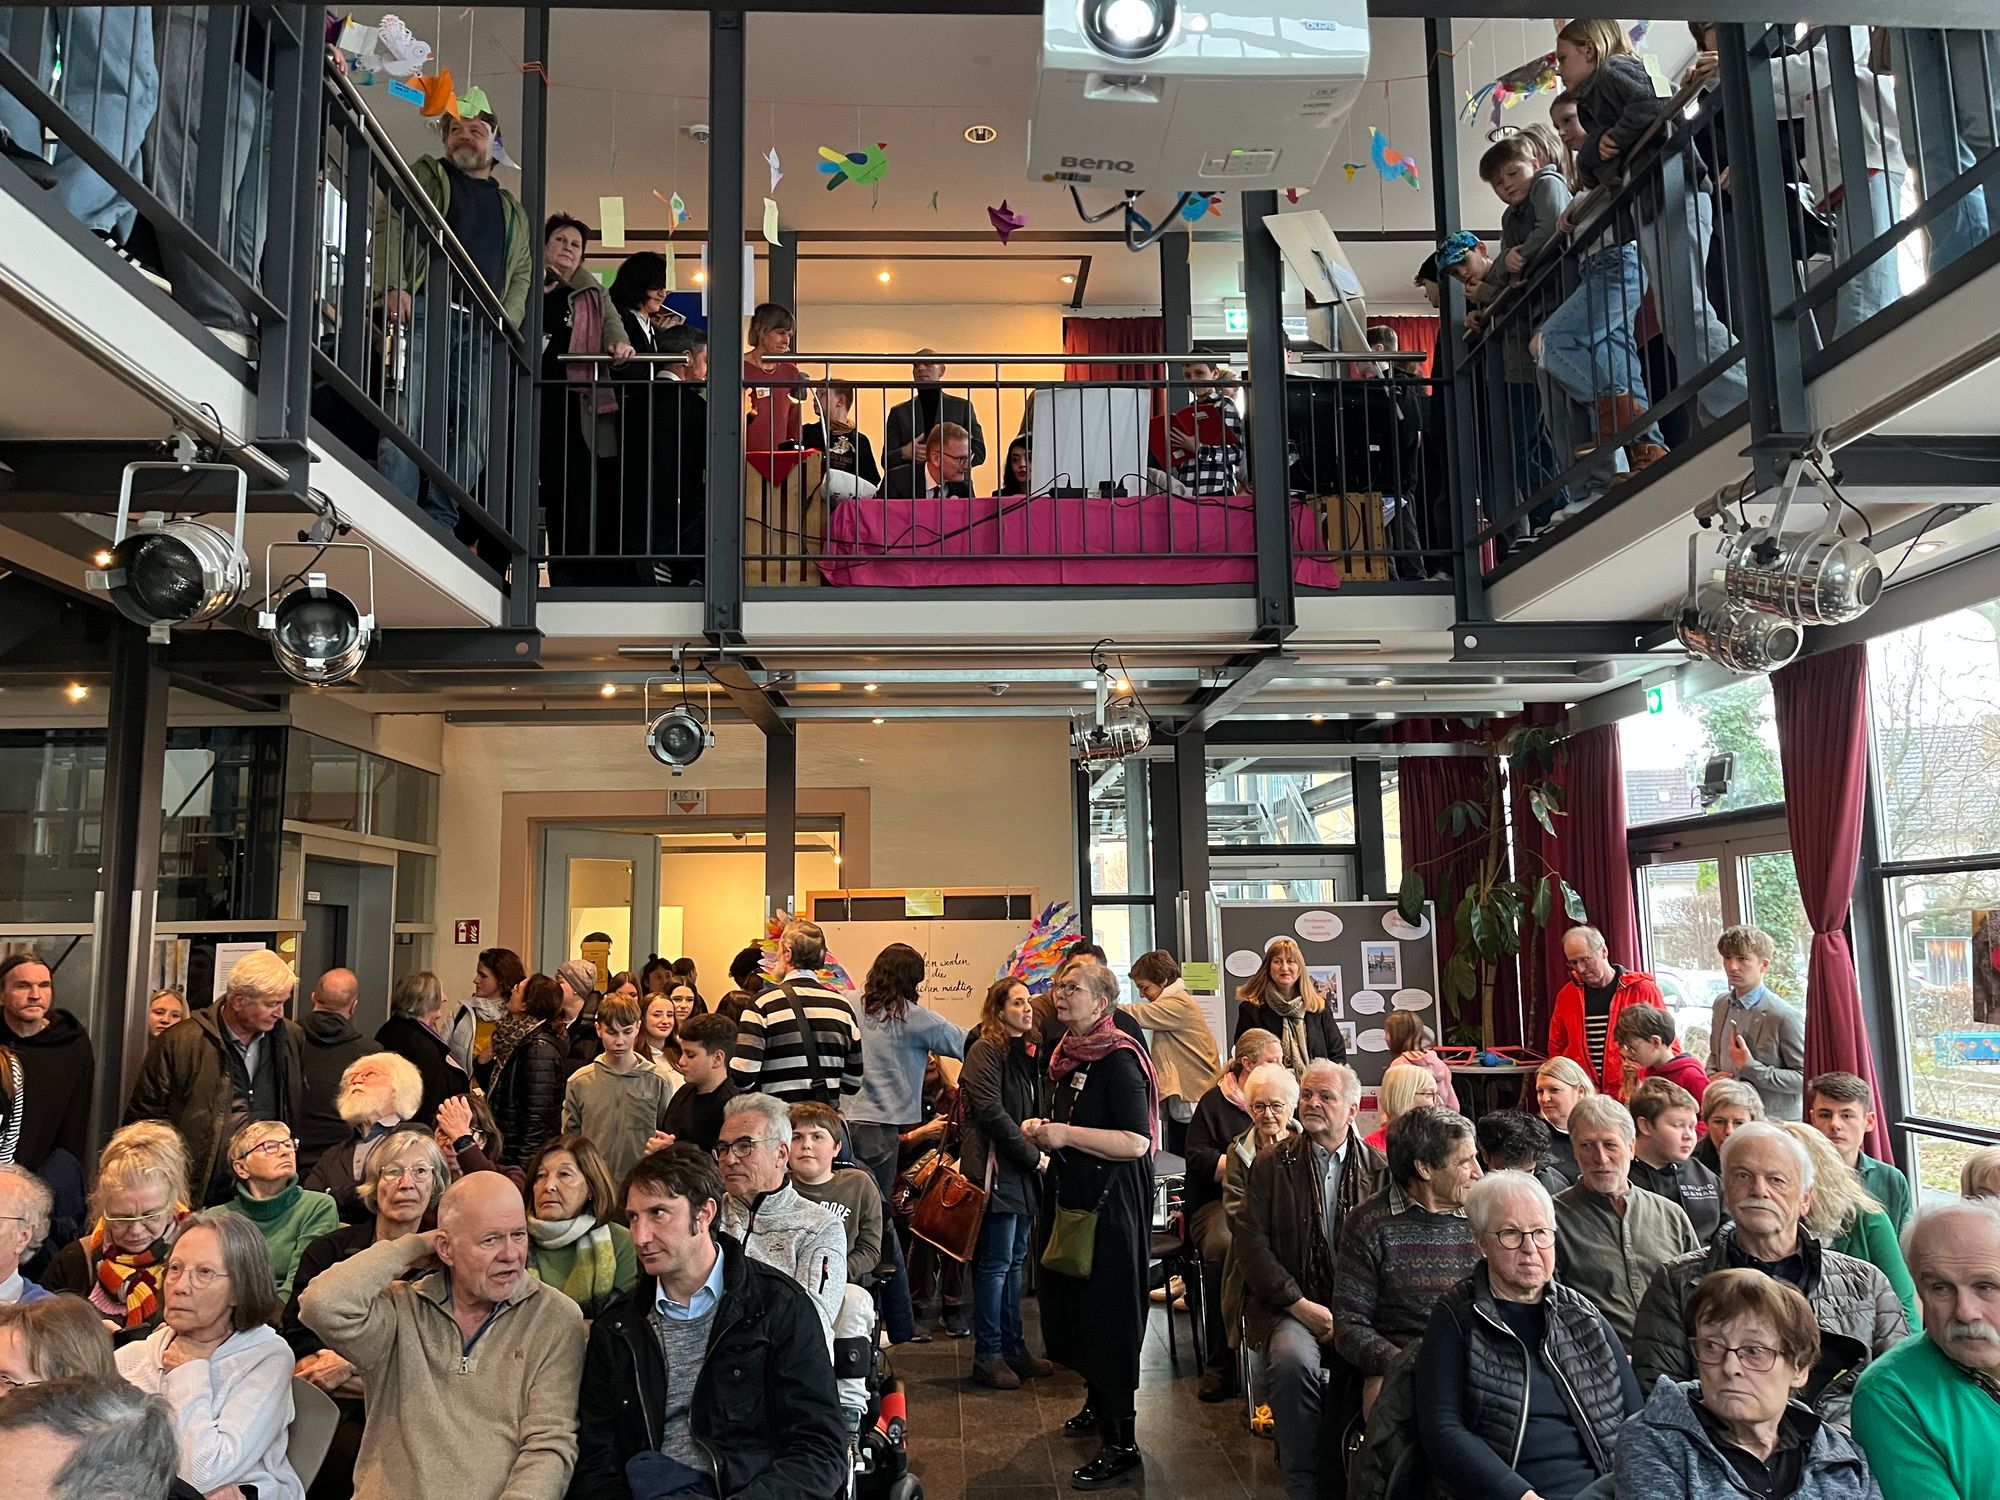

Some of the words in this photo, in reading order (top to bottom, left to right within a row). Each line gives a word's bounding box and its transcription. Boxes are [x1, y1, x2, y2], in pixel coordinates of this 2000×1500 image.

[1060, 156, 1136, 174] BenQ
[932, 967, 947, 978] die
[1680, 1183, 1715, 1192] BRUNO
